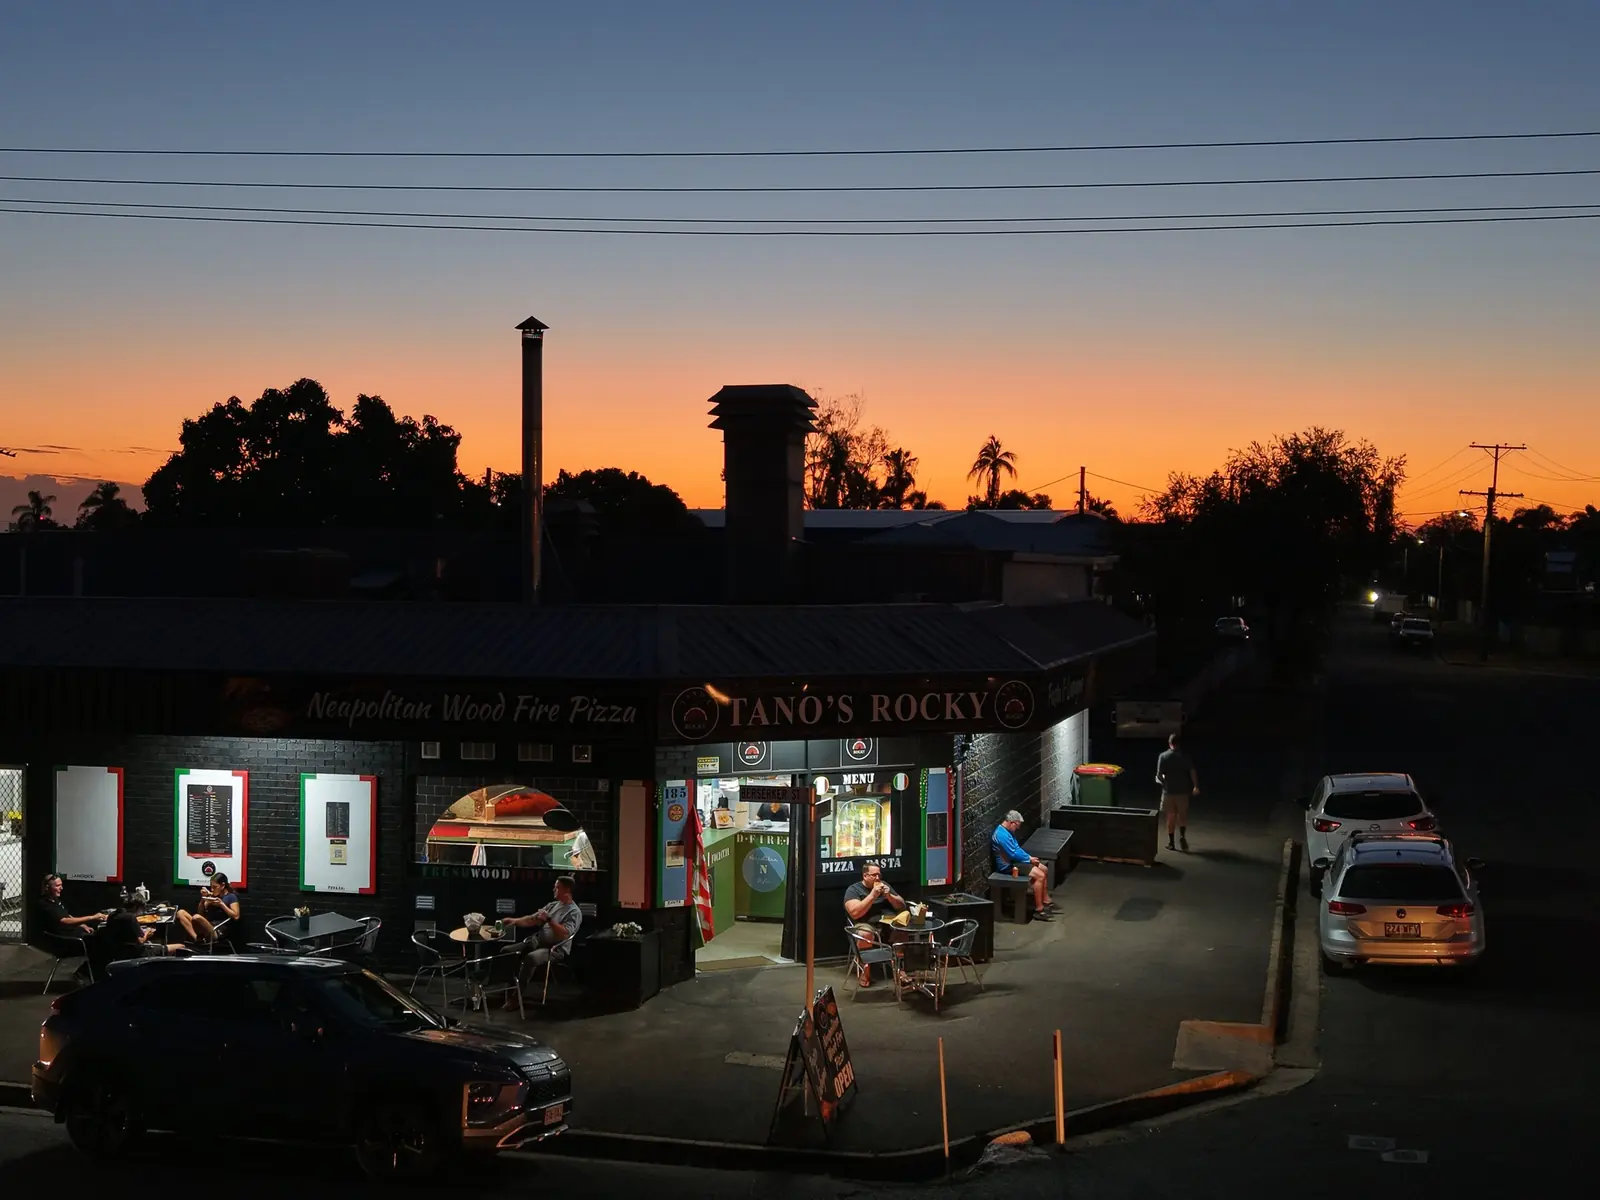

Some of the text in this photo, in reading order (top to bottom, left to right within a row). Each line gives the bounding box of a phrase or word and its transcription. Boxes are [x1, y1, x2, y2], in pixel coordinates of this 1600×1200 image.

[306, 689, 637, 729] Neapolitan Wood Fire Pizza
[728, 691, 988, 728] TANO'S ROCKY
[842, 772, 875, 785] MENU
[665, 787, 687, 799] 185
[741, 787, 801, 801] BERSERKER ST
[821, 860, 855, 873] PIZZA
[470, 867, 511, 880] WOOD
[834, 1060, 855, 1099] OPEN
